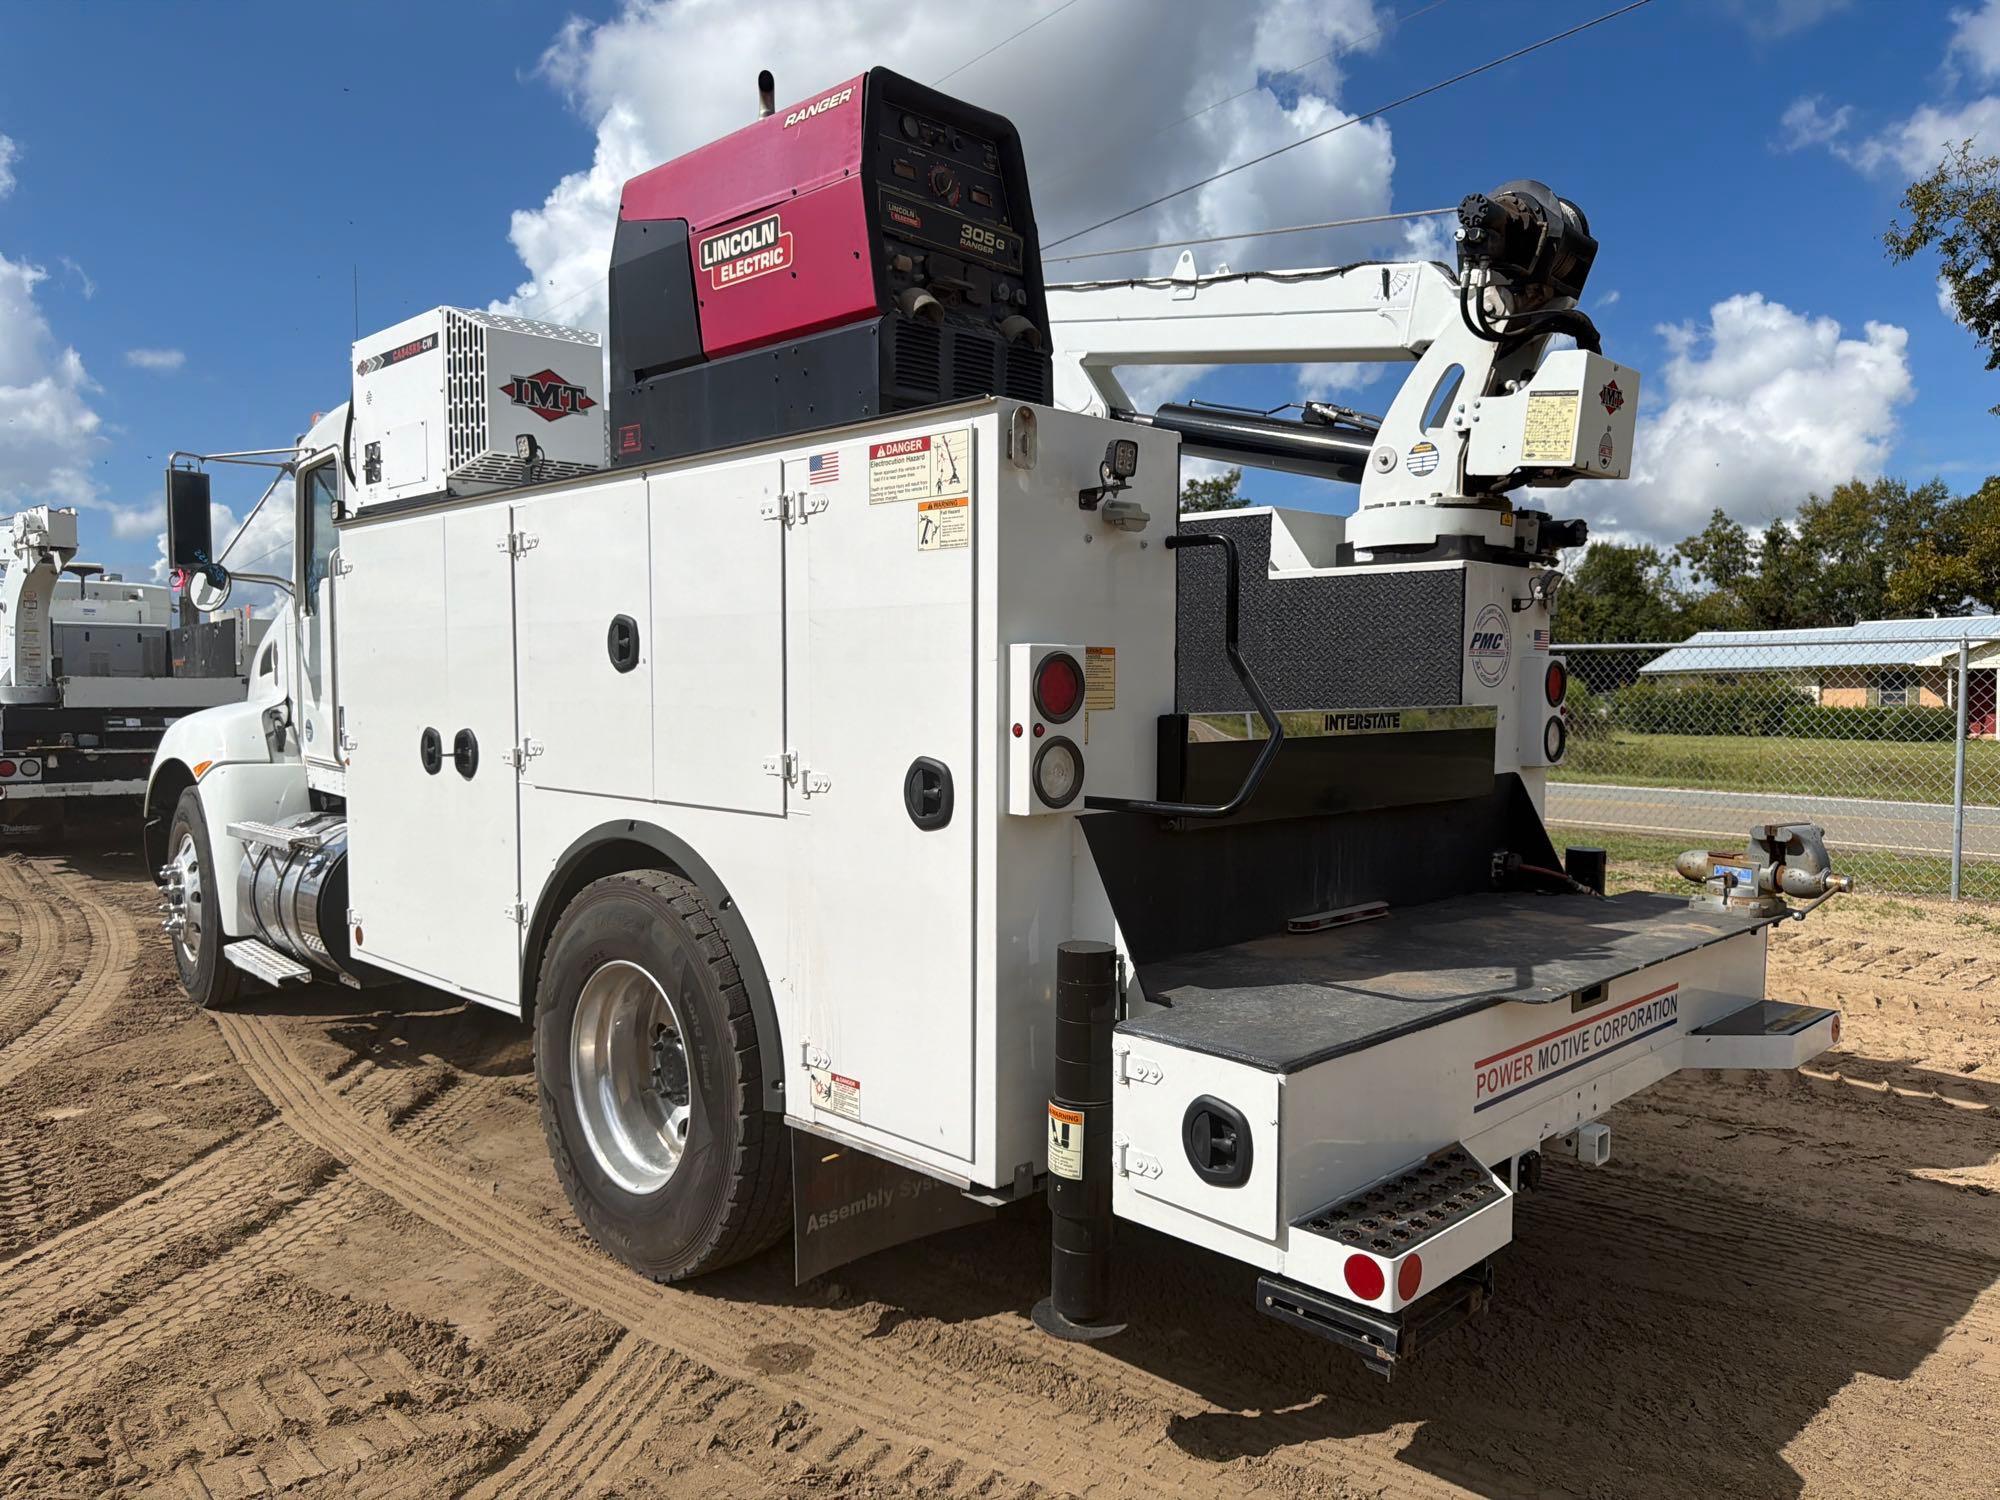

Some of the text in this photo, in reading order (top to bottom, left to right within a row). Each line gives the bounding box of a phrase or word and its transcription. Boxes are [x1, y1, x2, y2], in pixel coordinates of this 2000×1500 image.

[783, 87, 853, 128] RANGER
[887, 203, 915, 218] LINCOLN
[703, 220, 775, 265] LINCOLN
[959, 238, 995, 255] RANGER
[720, 246, 784, 282] ELECTRIC
[512, 375, 586, 413] IMT
[886, 439, 922, 455] DANGER
[870, 454, 925, 468] Electrocution Hazard
[932, 500, 958, 509] WARNING
[1469, 632, 1503, 650] PMC
[1324, 712, 1400, 731] INTERSTATE
[1476, 993, 1678, 1098] POWER MOTIVE CORPORATION
[806, 1187, 894, 1235] Assembly
